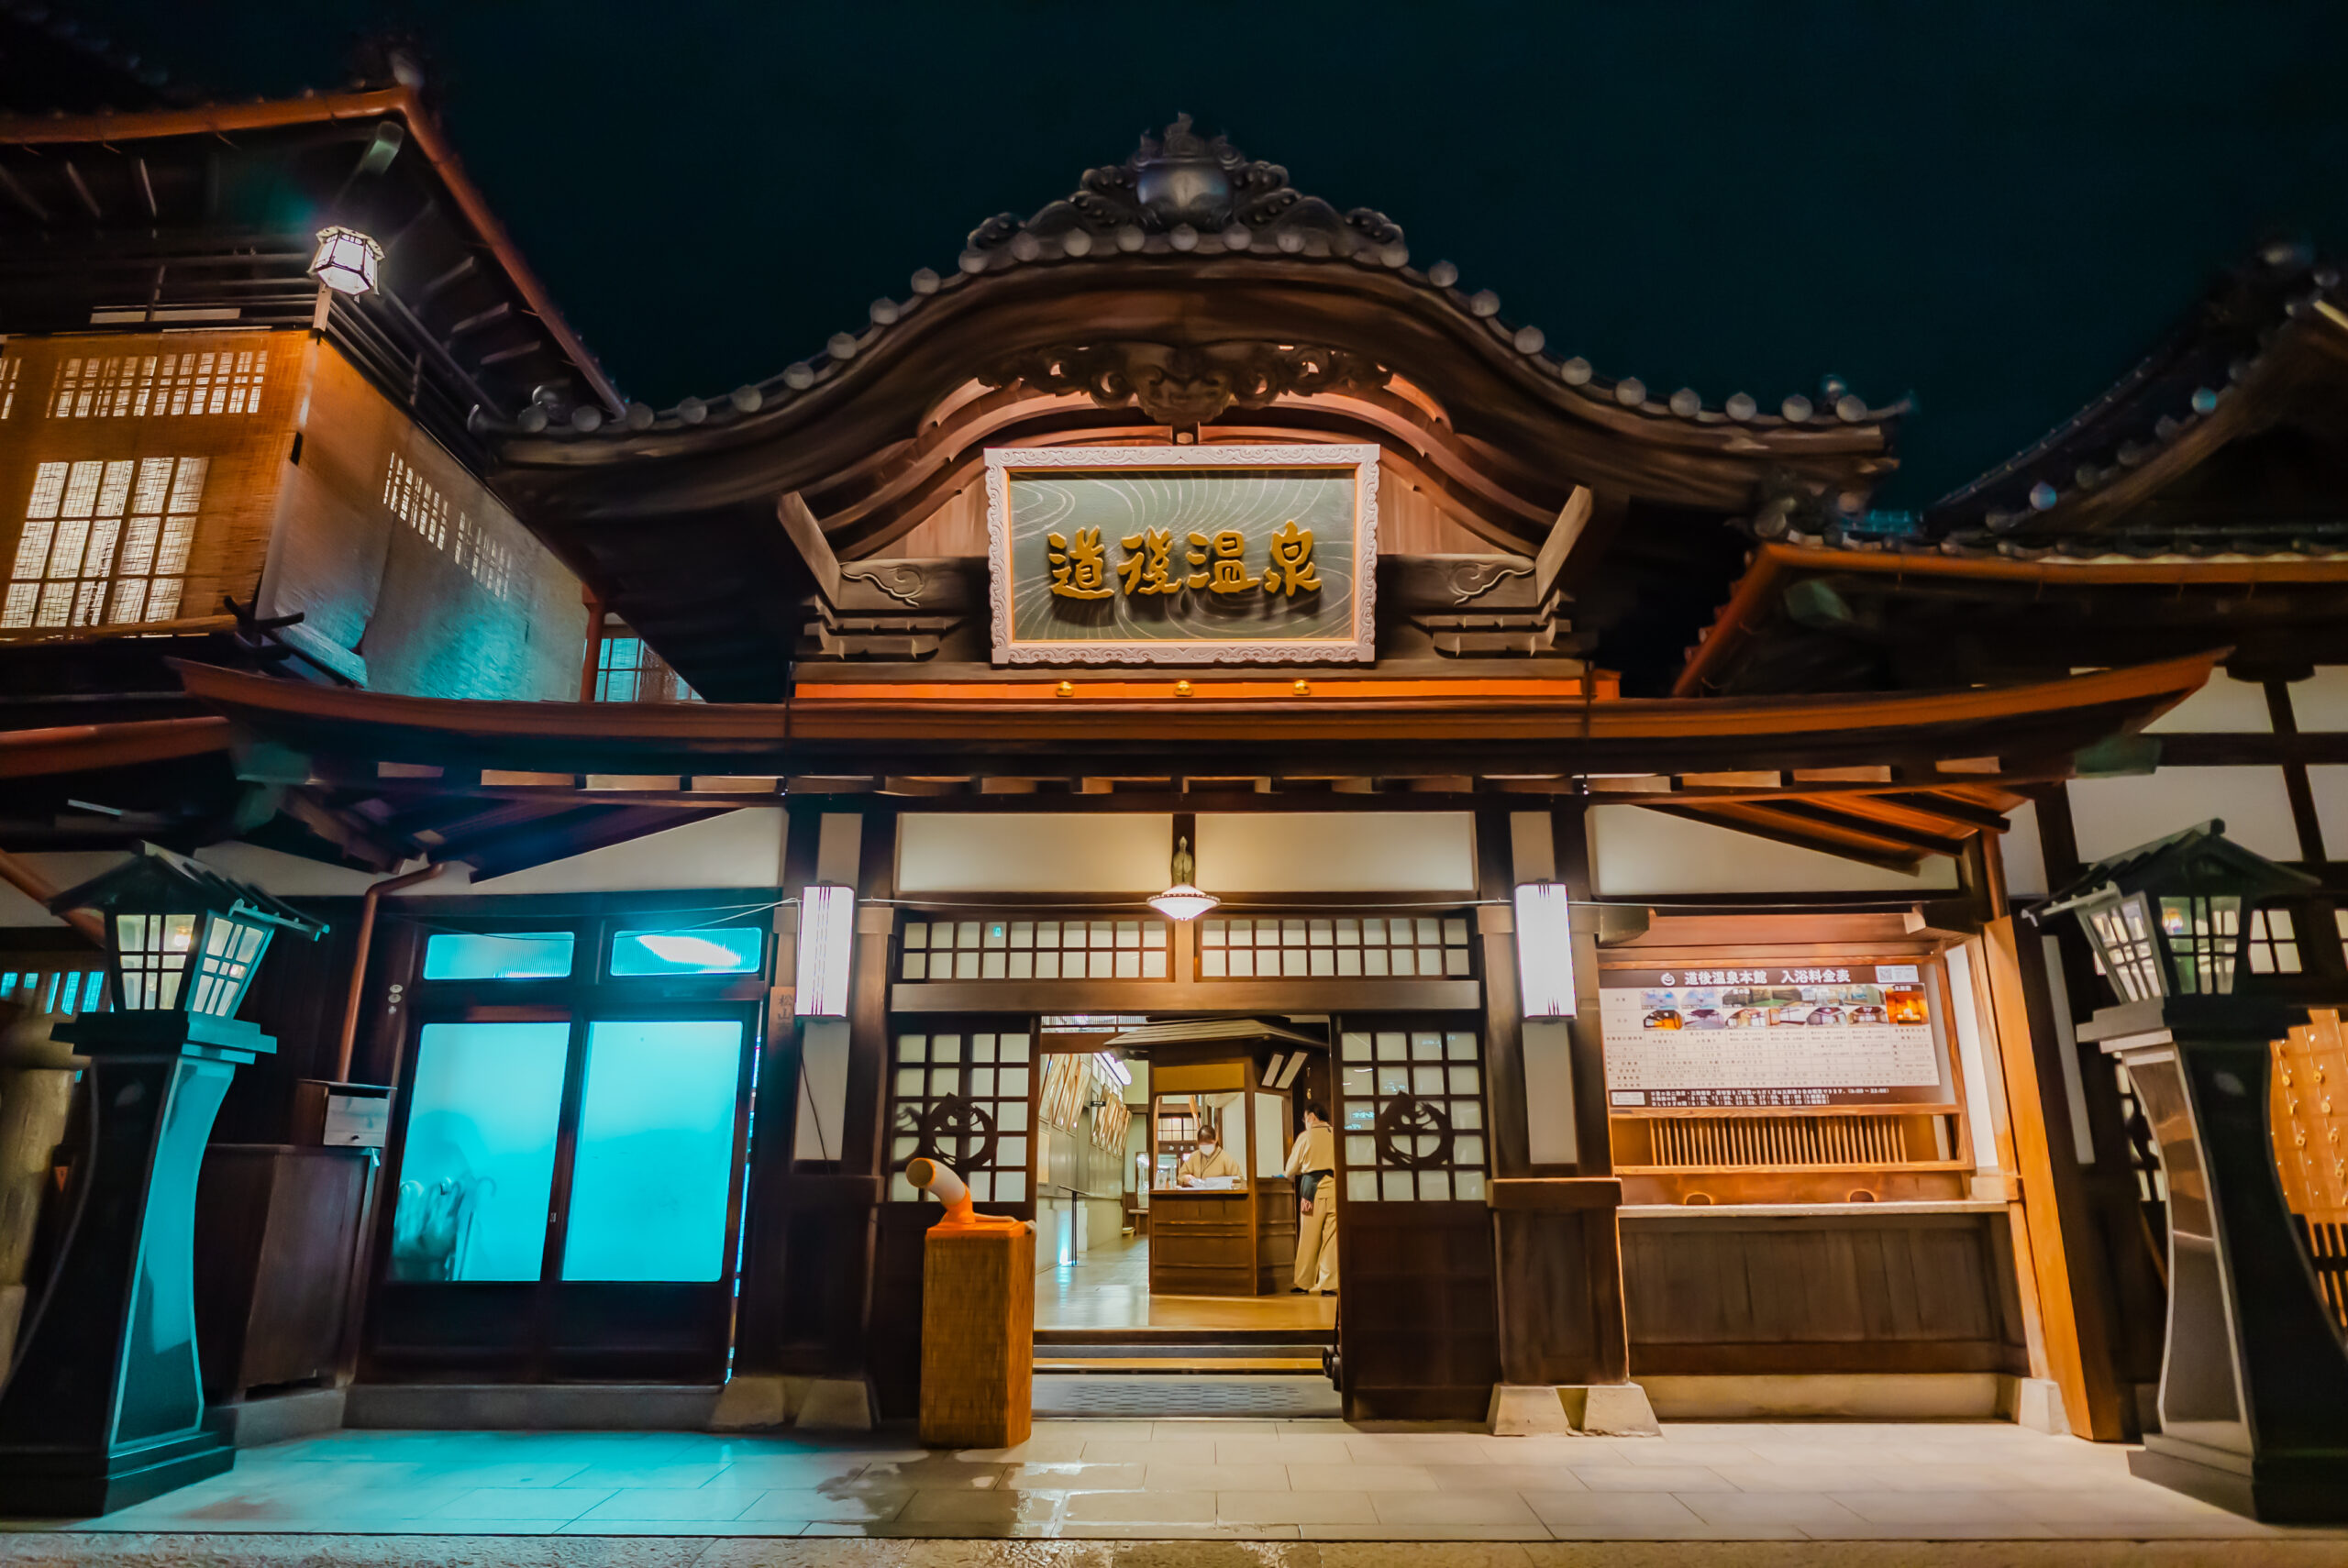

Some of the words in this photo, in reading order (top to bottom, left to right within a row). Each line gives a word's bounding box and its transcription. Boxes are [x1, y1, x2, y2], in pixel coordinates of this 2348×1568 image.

[1047, 520, 1322, 600] 道後温泉
[1684, 970, 1767, 986] 道後温泉本館
[1780, 968, 1851, 984] 入浴料金表
